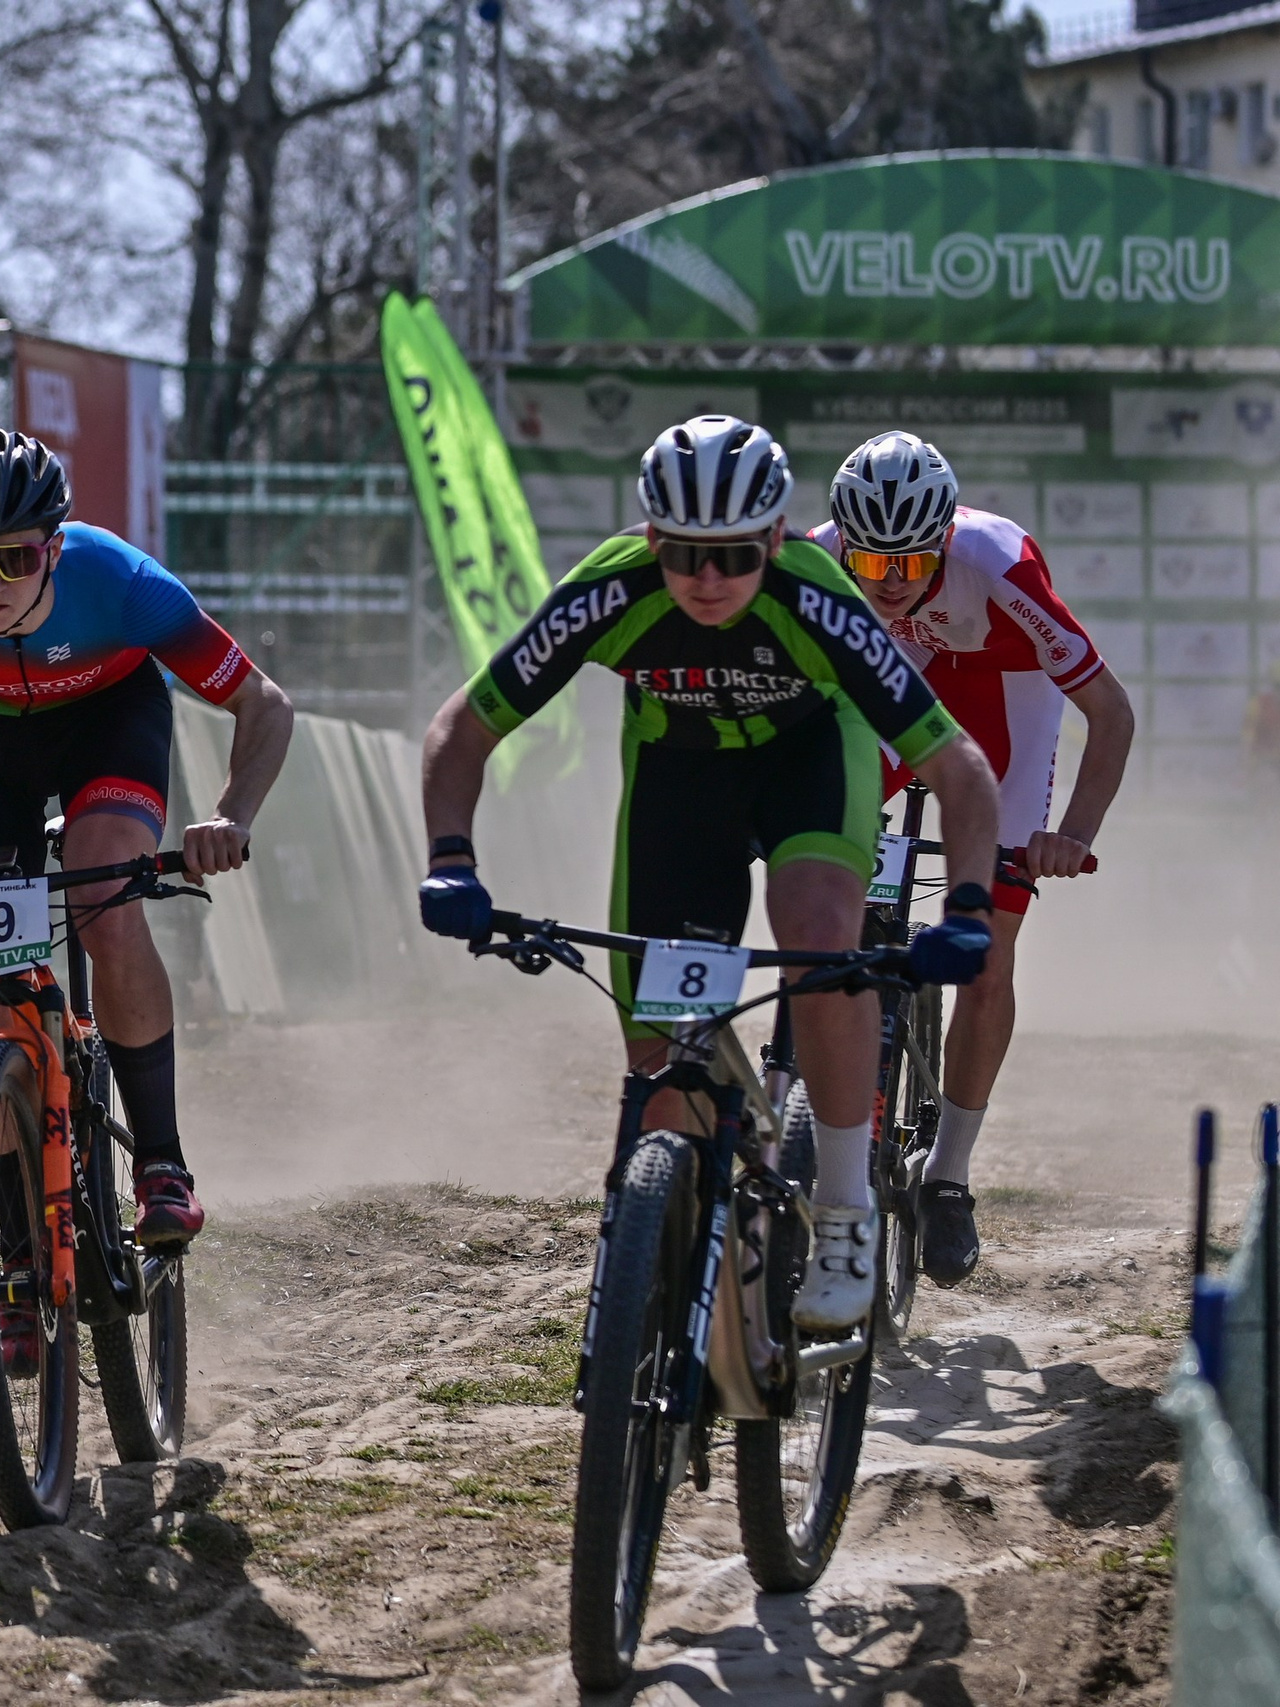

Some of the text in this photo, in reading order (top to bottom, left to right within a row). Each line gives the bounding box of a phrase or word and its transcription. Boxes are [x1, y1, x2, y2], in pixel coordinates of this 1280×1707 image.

[784, 229, 1231, 302] VELOTV.RU
[510, 578, 629, 688] RUSSIA
[797, 584, 911, 703] RUSSIA
[1008, 598, 1056, 646] МОСКВА
[214, 652, 242, 690] REGION
[86, 786, 165, 824] MOSCO
[679, 962, 708, 998] 8
[44, 1107, 67, 1146] 32
[58, 1205, 73, 1250] FOX
